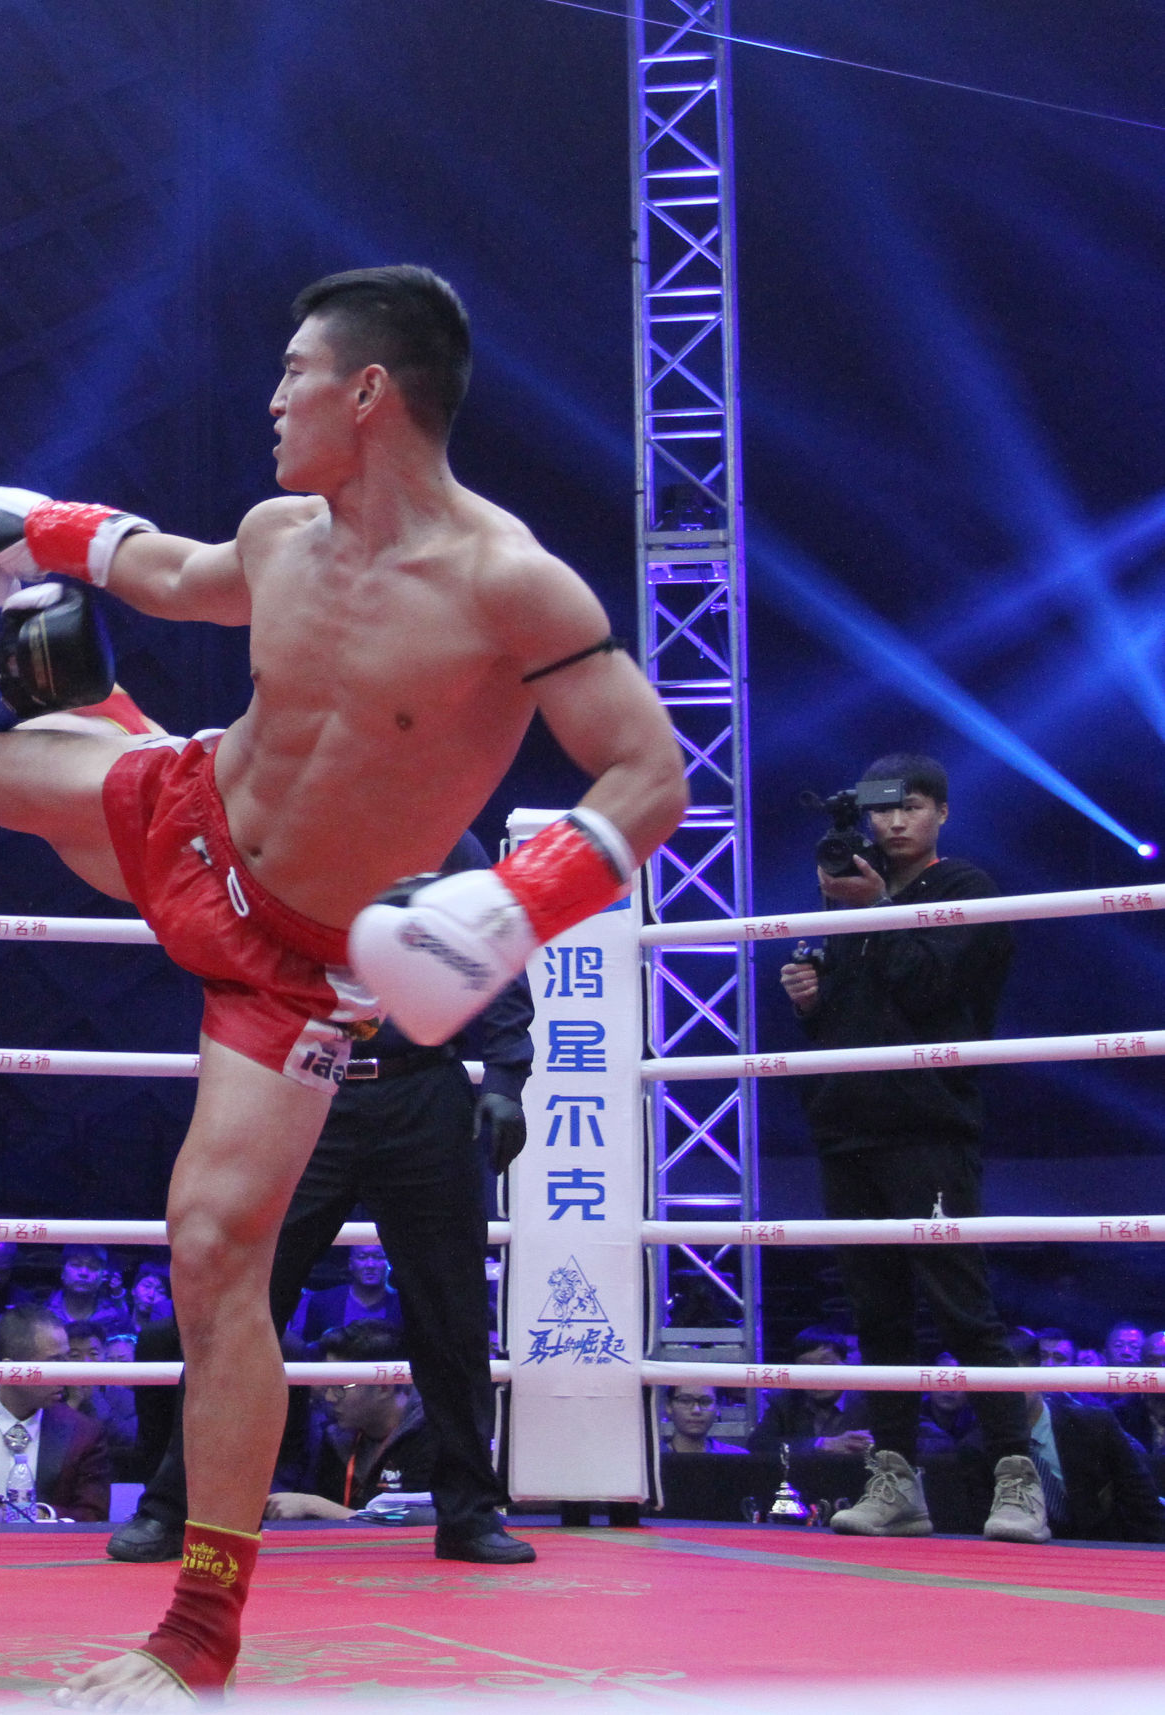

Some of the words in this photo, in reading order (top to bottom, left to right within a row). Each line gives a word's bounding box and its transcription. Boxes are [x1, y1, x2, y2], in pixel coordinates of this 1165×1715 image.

[1100, 892, 1153, 910] 万名扬
[915, 908, 964, 925] 万名扬
[745, 921, 789, 937] 万名扬
[1095, 1036, 1145, 1055] 万名扬
[0, 1053, 50, 1070] 万名扬
[913, 1047, 960, 1064] 万名扬
[745, 1056, 787, 1074] 万名扬
[544, 946, 607, 1220] 鸿星尔克
[741, 1225, 784, 1241] 万名扬
[912, 1223, 961, 1240] 万名扬
[1098, 1220, 1150, 1238] 万名扬
[745, 1367, 790, 1385] 万名扬
[920, 1370, 967, 1387] 万名扬
[1106, 1371, 1158, 1389] 万名扬
[181, 1553, 224, 1576] KING
